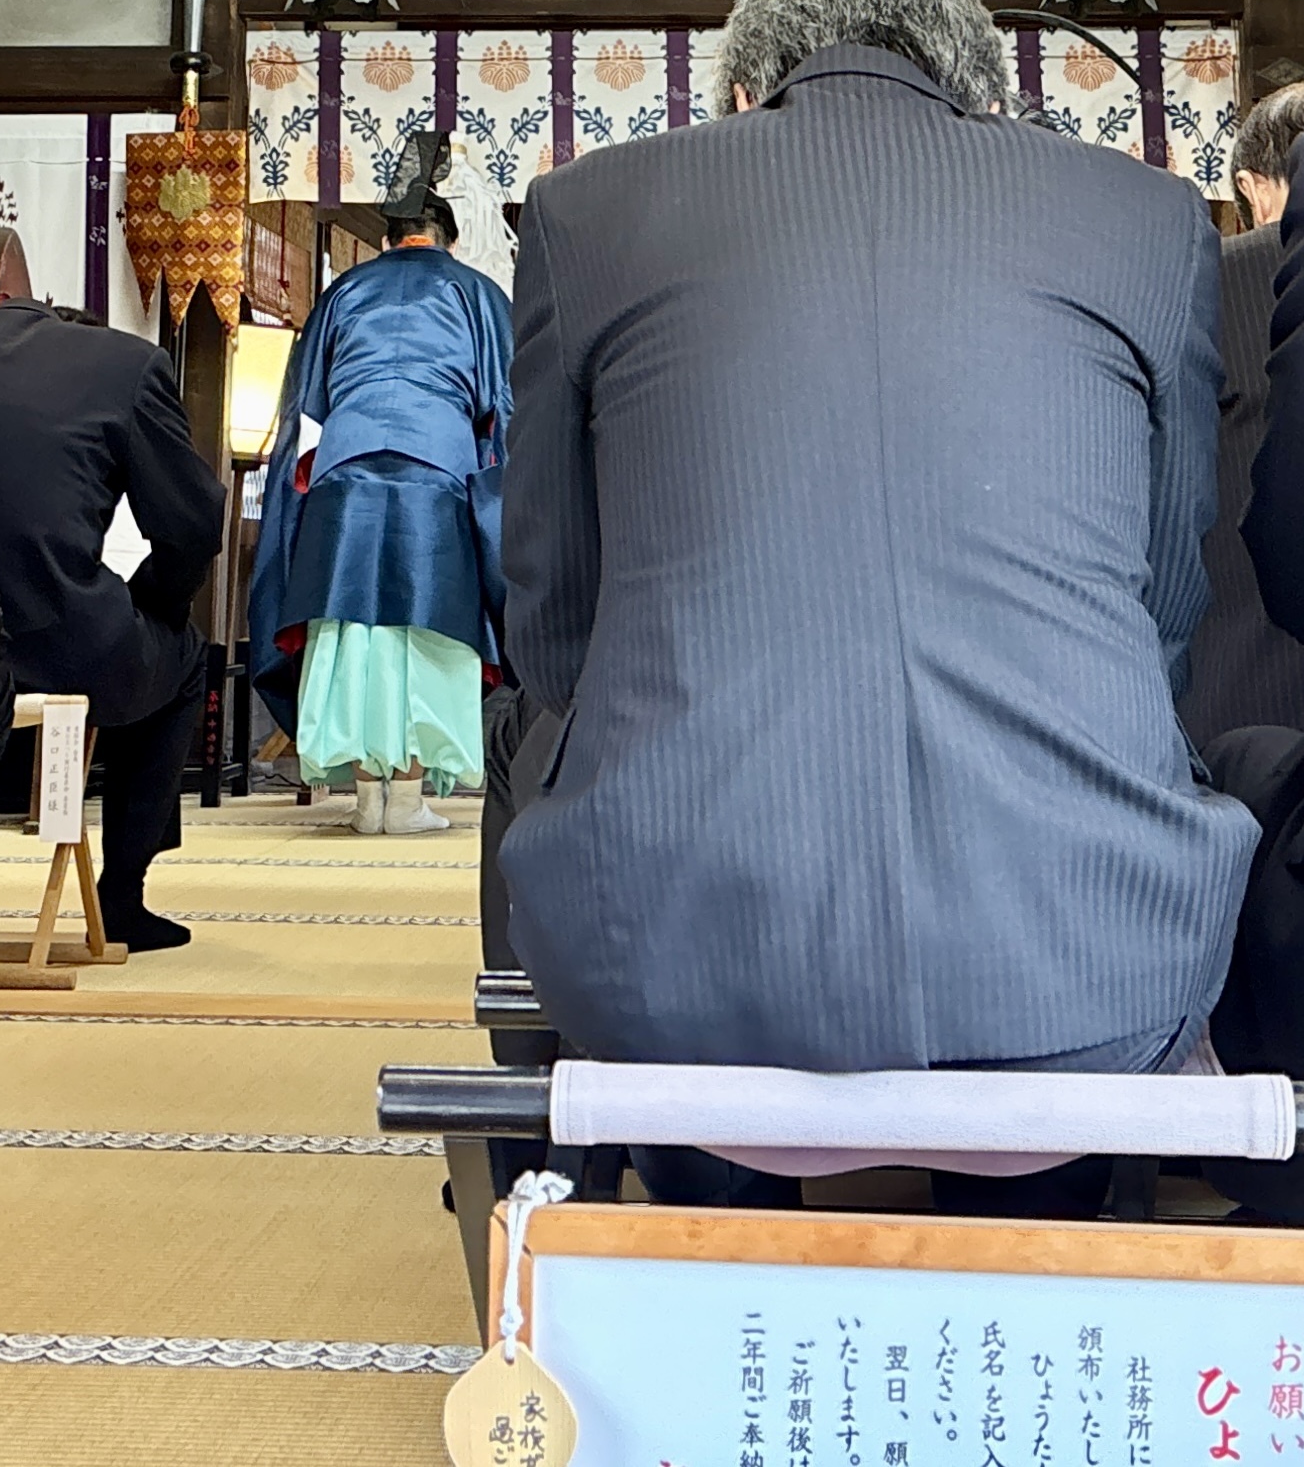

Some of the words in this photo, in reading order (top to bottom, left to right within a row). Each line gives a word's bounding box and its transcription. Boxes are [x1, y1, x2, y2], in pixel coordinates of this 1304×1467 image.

[836, 1316, 862, 1466] いたします。
[933, 1317, 959, 1442] ください。
[981, 1321, 1007, 1467] 氏名を記入
[1031, 1353, 1055, 1467] ひょうた
[1077, 1325, 1104, 1466] 頒布いたし
[1126, 1355, 1154, 1466] 社務所に
